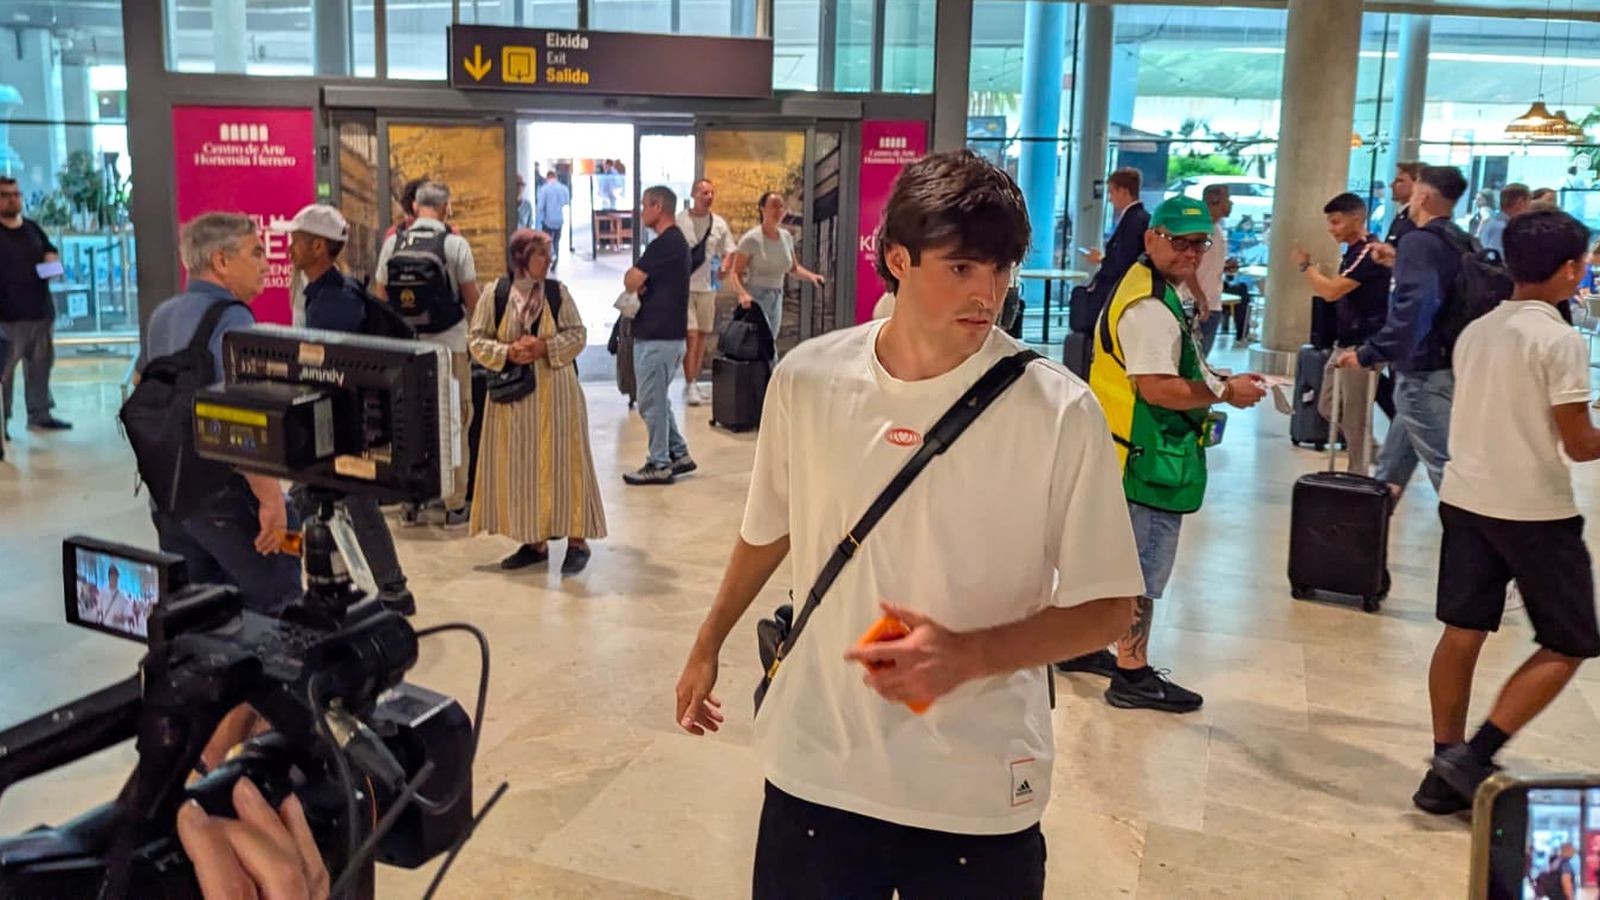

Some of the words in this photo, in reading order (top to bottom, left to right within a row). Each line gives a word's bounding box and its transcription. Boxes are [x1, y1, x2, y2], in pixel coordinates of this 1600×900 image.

[546, 32, 589, 50] Eixida
[546, 50, 567, 65] Exit
[546, 66, 589, 84] Salida
[203, 142, 243, 154] Centro
[245, 143, 259, 154] de
[261, 143, 286, 156] Arte
[194, 152, 251, 166] Hortensia
[252, 154, 296, 168] Herrero
